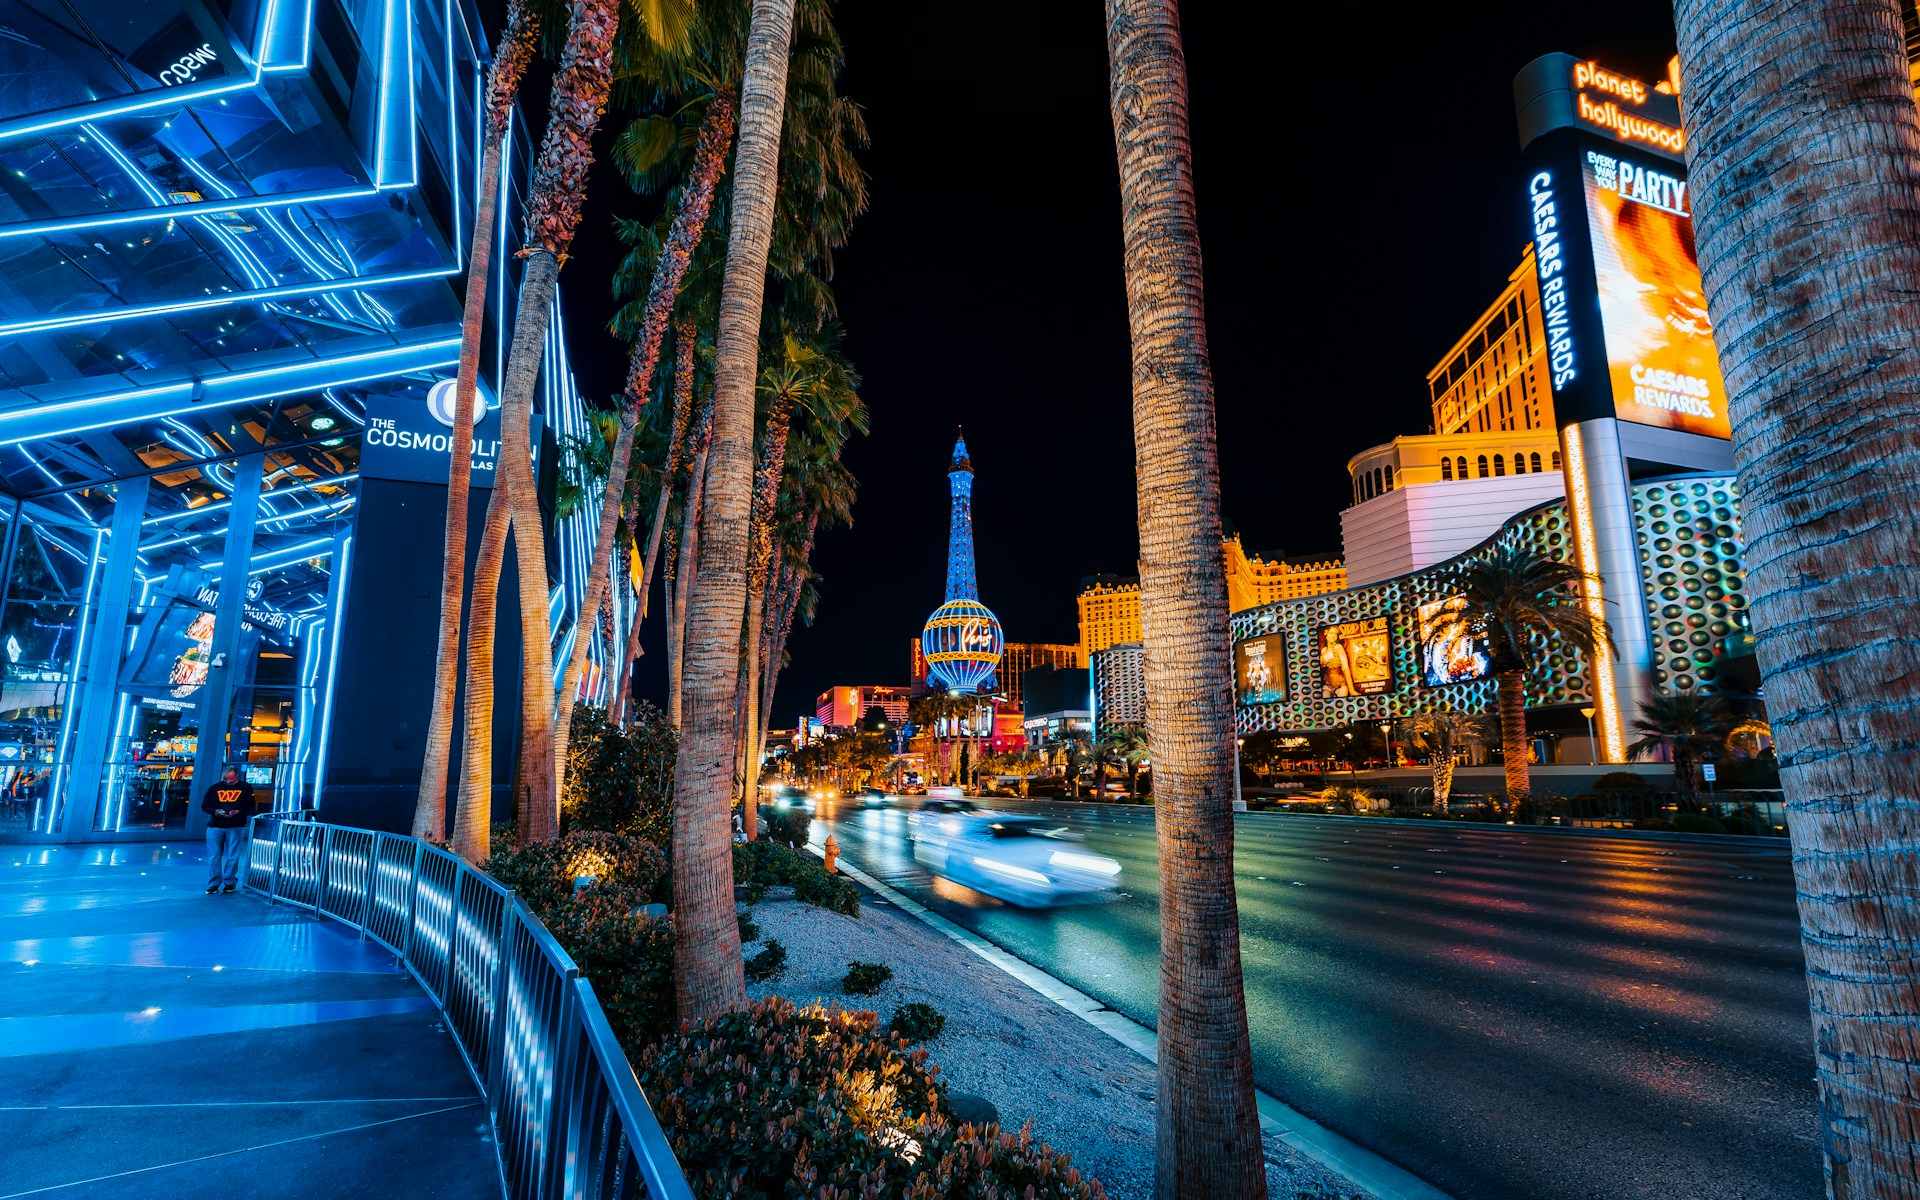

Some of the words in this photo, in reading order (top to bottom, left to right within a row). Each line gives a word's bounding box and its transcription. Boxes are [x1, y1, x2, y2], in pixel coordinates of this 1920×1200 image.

[1574, 62, 1646, 104] planet
[1580, 94, 1684, 149] hollywood
[1587, 151, 1617, 169] EVERY
[1595, 164, 1616, 180] WAY
[1595, 175, 1616, 191] YOU
[1619, 161, 1686, 212] PARTY
[1530, 172, 1562, 279] CAESARS
[1542, 277, 1575, 390] REWARDS.
[1630, 364, 1709, 397] CAESARS
[370, 417, 396, 430] THE
[962, 618, 992, 654] Paris
